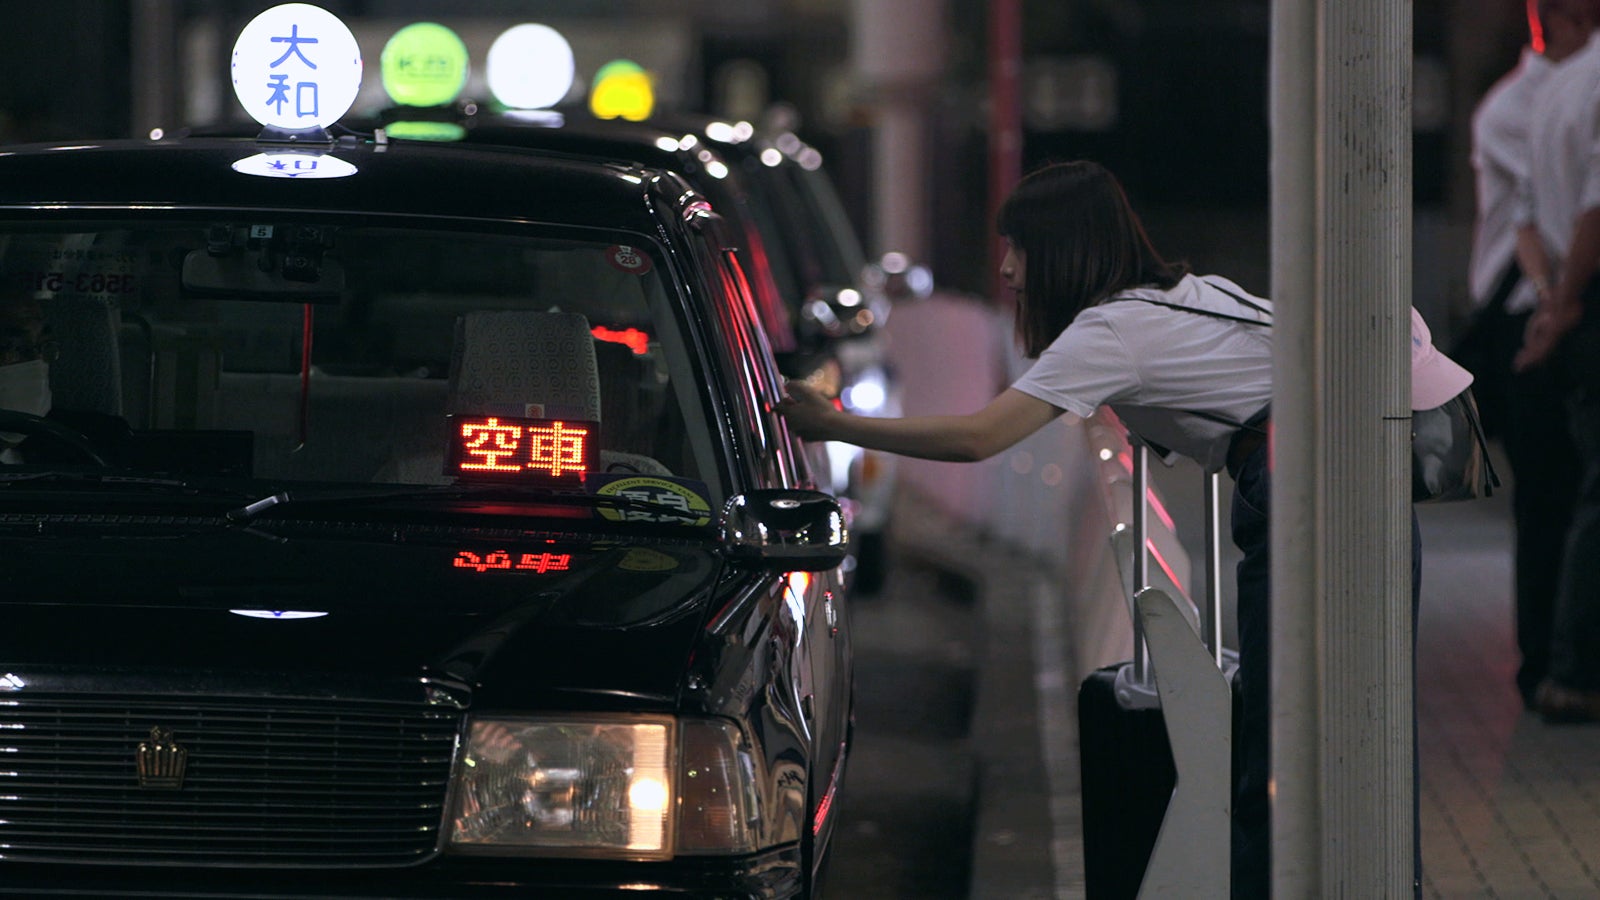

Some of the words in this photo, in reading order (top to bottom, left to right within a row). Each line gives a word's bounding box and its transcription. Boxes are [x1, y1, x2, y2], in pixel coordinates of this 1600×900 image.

[266, 24, 318, 117] 大和
[256, 228, 267, 237] 5
[620, 255, 637, 265] 28
[461, 418, 587, 477] 空車
[642, 479, 674, 488] SERVICE
